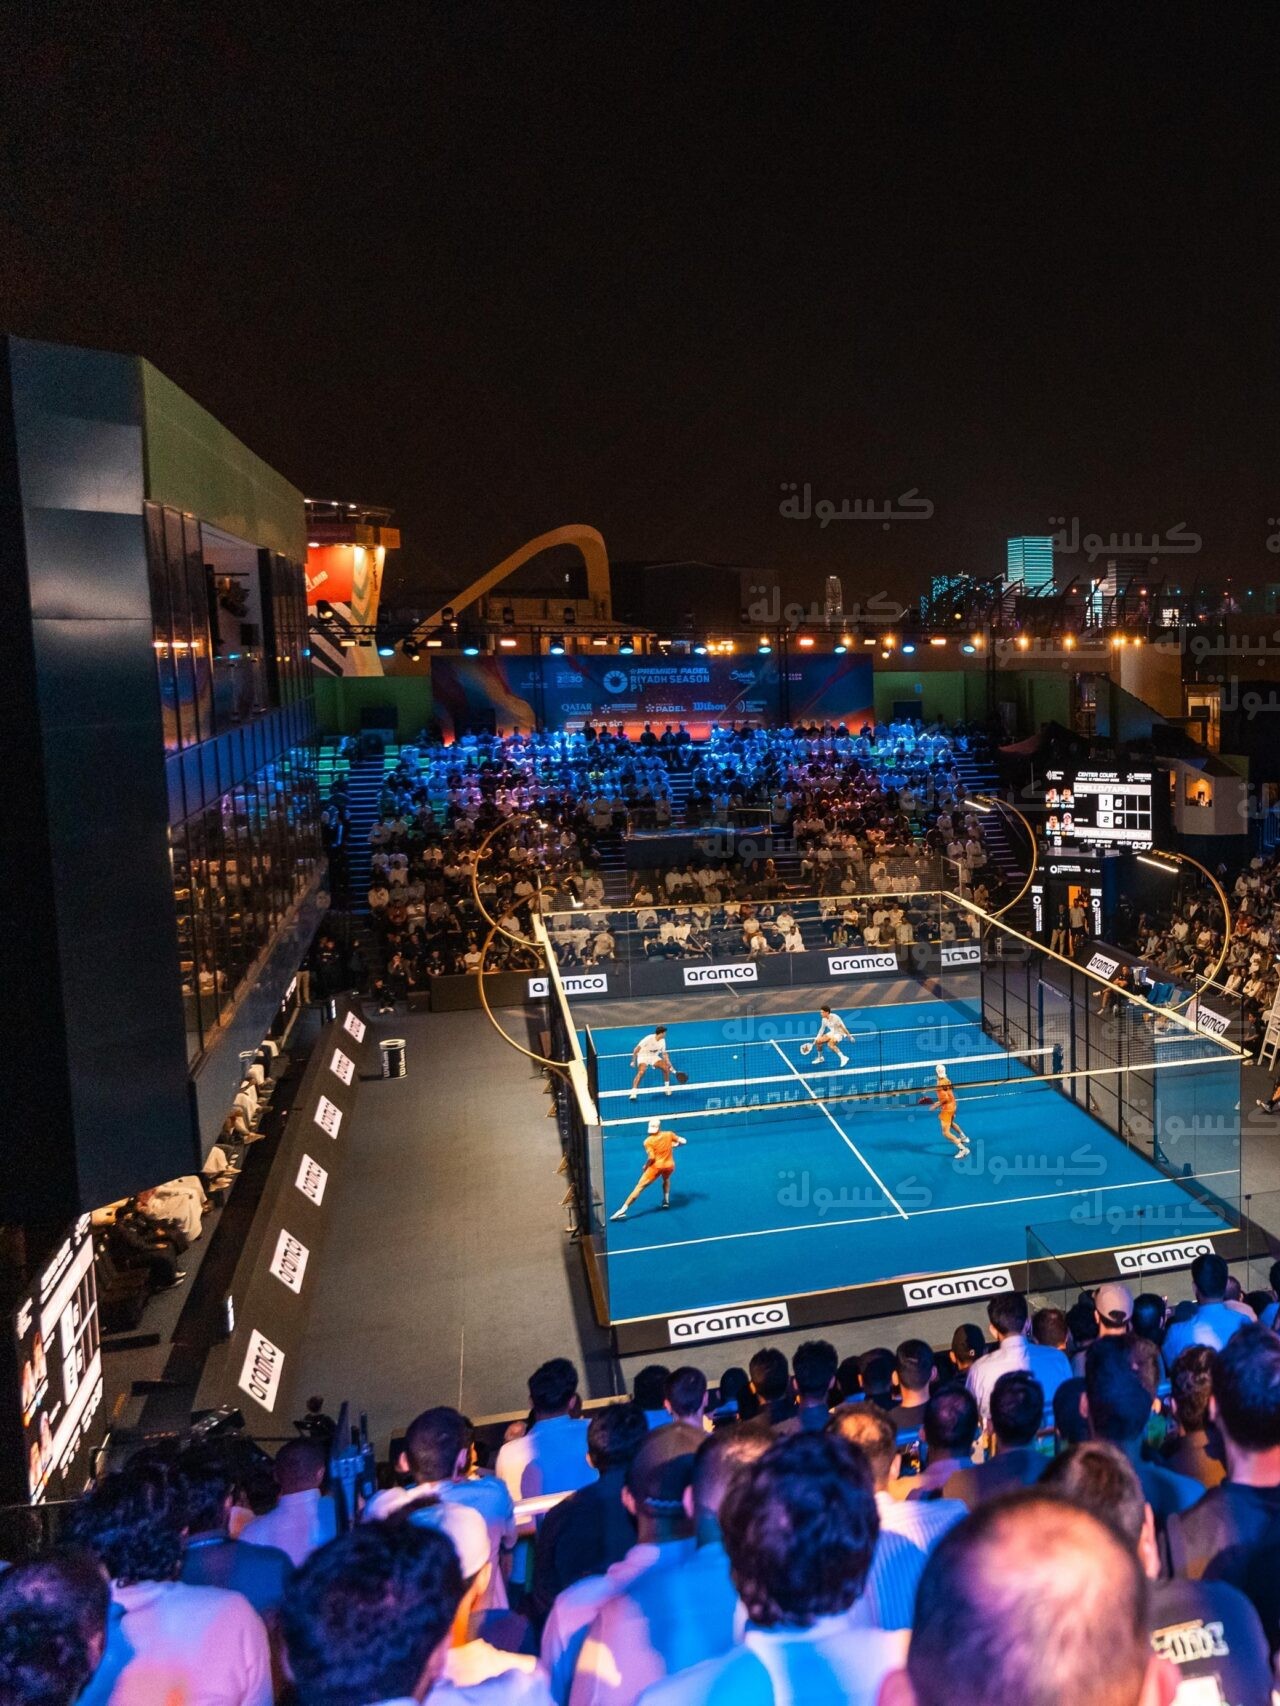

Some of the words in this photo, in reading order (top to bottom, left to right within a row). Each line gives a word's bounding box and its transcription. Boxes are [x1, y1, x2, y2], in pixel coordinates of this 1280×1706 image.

[637, 667, 677, 675] PREMIER
[680, 667, 709, 675] PADEL
[630, 675, 667, 684] RIYADH
[670, 675, 710, 683] SEASON
[561, 703, 592, 712] QATAR
[656, 705, 686, 713] PADEL
[693, 701, 727, 711] Wilson
[1132, 841, 1153, 849] 0:37
[831, 957, 894, 970] aramco
[1090, 957, 1115, 975] aramco
[687, 967, 754, 981] aramco
[533, 978, 604, 992] amco
[302, 1161, 321, 1198] aramco
[279, 1238, 301, 1285] aramco
[1121, 1245, 1210, 1267] aramco
[909, 1275, 1008, 1300] aramco
[674, 1309, 784, 1336] aramco
[249, 1340, 277, 1401] aramco
